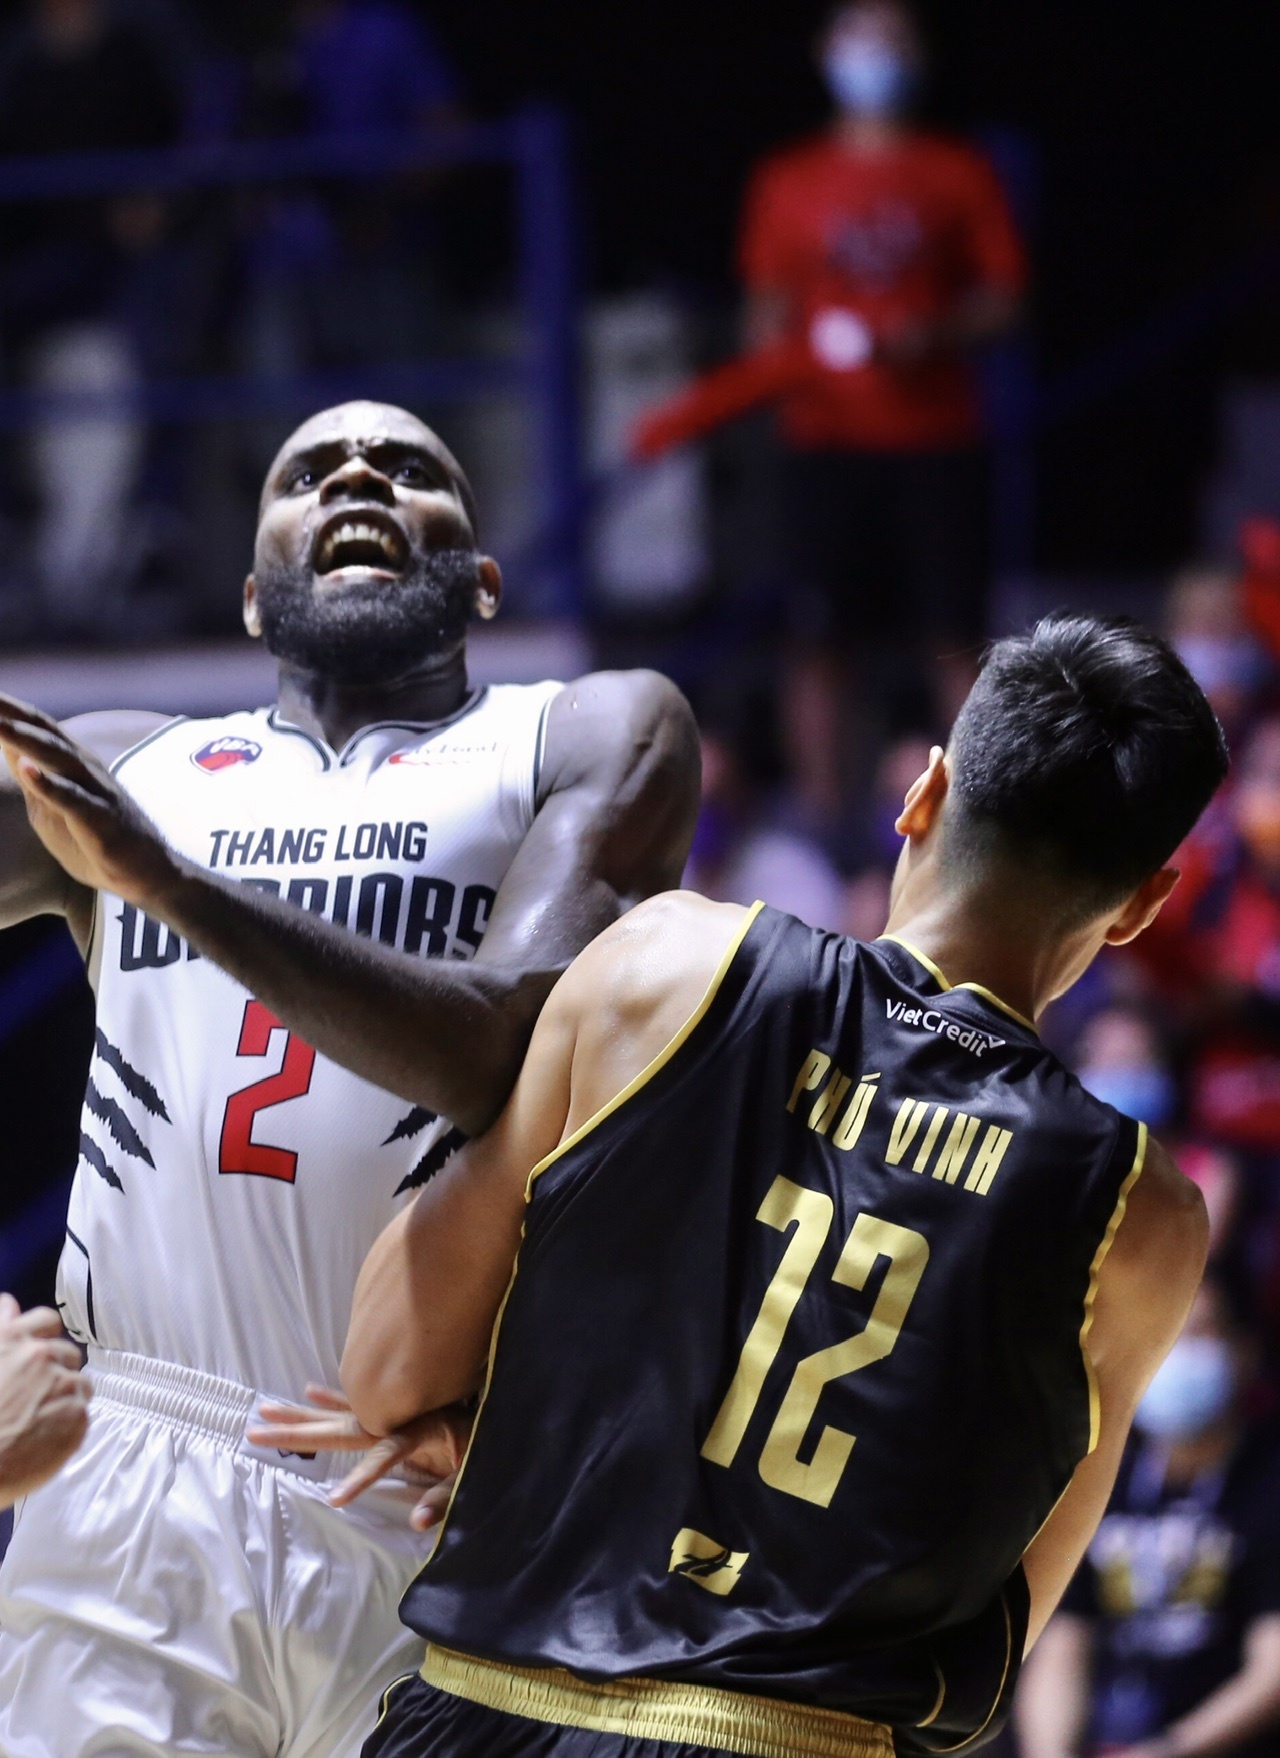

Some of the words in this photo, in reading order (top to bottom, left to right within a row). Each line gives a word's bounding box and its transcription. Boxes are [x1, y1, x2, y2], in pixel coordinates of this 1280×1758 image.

[209, 827, 327, 868] THANG
[334, 821, 429, 862] LONG
[115, 871, 497, 972] WIORS
[886, 997, 990, 1058] VietCredit
[218, 999, 317, 1185] 2
[785, 1047, 882, 1151] PHÚ
[884, 1097, 1014, 1196] VINH
